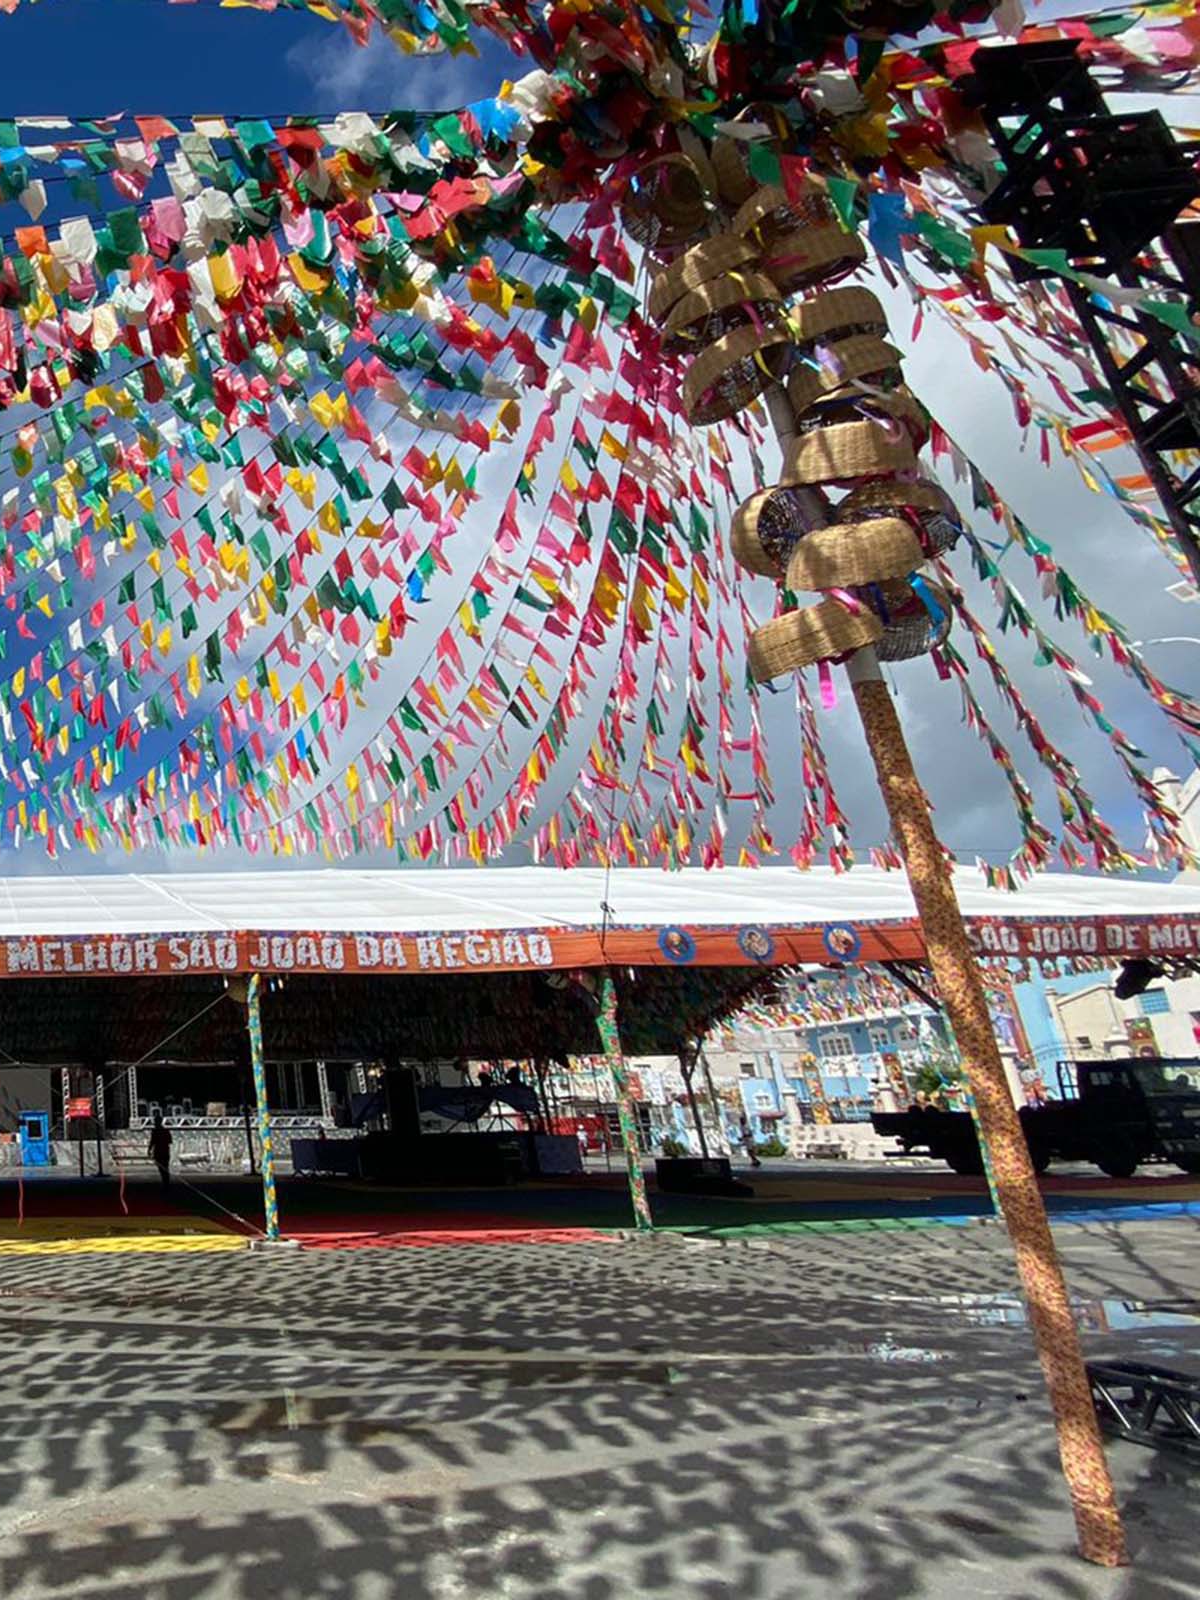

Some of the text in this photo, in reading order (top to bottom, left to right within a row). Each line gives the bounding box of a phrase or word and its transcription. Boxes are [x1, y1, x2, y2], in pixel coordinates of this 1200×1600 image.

[1104, 923, 1141, 950] DE
[7, 938, 158, 973] MELHOR
[356, 935, 408, 968] DA
